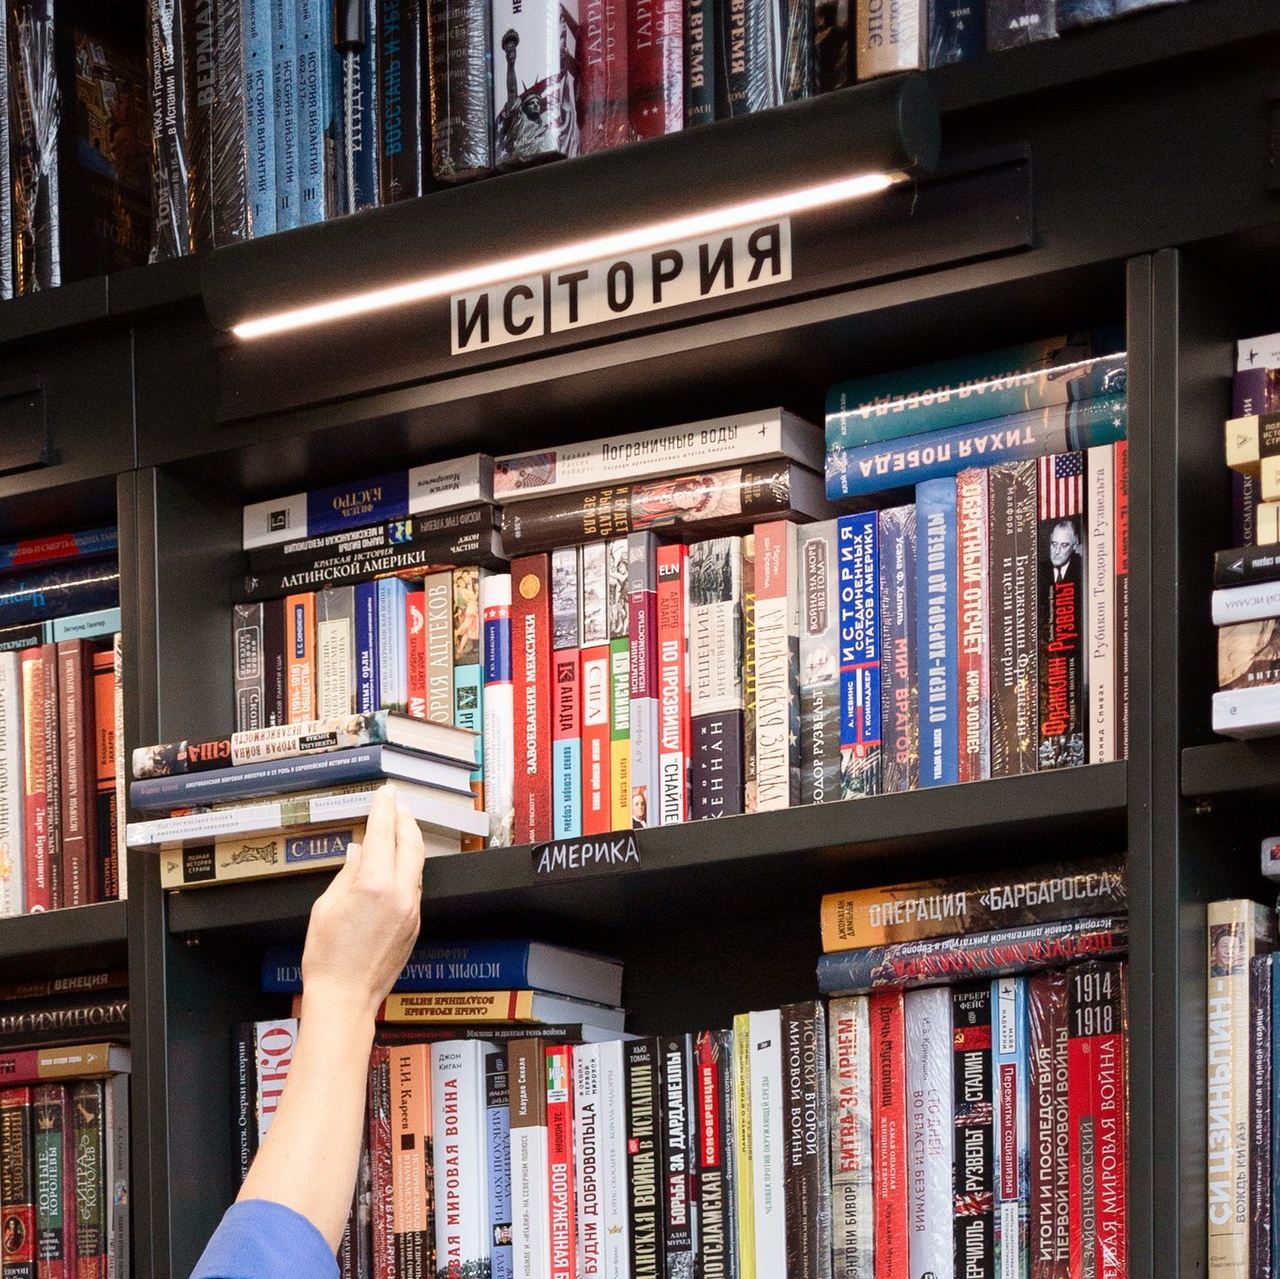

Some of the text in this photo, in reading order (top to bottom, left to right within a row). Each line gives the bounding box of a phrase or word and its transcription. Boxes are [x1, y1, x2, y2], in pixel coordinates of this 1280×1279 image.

[457, 223, 784, 349] ИСТОРИЯ
[602, 425, 737, 461] Пограничные воды
[858, 424, 1035, 477] ТИХАЯ ПОБЕДА
[333, 487, 382, 510] КАСТРО
[280, 550, 426, 589] ЛАТИНСКОЙ АМЕРИКИ
[314, 547, 394, 569] КРАТКАЯ ИСТОРИЯ
[659, 563, 680, 576] ELN
[964, 482, 983, 656] ОБРАТНЫЙ ОТСЧЕТ
[840, 525, 854, 661] ИСТОРИЯ
[853, 535, 863, 652] СОЕДИНЕННЫХ
[863, 523, 876, 659] ШТАТОВ АМЕРИКИ
[929, 511, 947, 724] ОТ ПЕРЛ-ХАРБОРА ДО ПОБЕДЫ
[526, 614, 538, 774] ЗАВОЕВАНИЕ МЕКСИКИ
[556, 663, 574, 731] КАНАДА
[663, 641, 679, 749] ПО ПРОЗВИЩУ
[291, 836, 346, 861] США
[537, 838, 640, 871] АМЕРИКА
[869, 872, 1122, 926] ОПЕРАЦИЯ «БАРБАРОССА»
[54, 973, 108, 990] ВЕНЕЦИЯ
[1074, 975, 1112, 1002] 1914
[1075, 1008, 1113, 1036] 1918
[438, 1052, 462, 1061] ДЖОН
[438, 1062, 462, 1070] КИГАН
[963, 1052, 983, 1101] СТАЛИН
[445, 1078, 458, 1137] ВОЙНА
[631, 1066, 652, 1137] ИСПАНИИ
[703, 1068, 716, 1165] КОНФЕРЕНЦИЯ
[838, 1018, 859, 1172] БИТВА ЗА АРНЕМ
[641, 1140, 653, 1150] В
[666, 1051, 685, 1226] БОРЬБА ЗА ДАРДАНЕЛЛЫ
[964, 1129, 985, 1197] РУЗВЕЛЬТ
[39, 1151, 49, 1216] ЮНЫЕ
[49, 1145, 58, 1216] КОРОЛЕВЫ
[447, 1144, 459, 1225] МИРОВАЯ
[582, 1103, 597, 1274] БУДНИ ДОБРОВОЛЬЦА
[633, 1151, 655, 1206] ВОЙНА
[551, 1163, 570, 1266] ВООРУЖЕННАЯ
